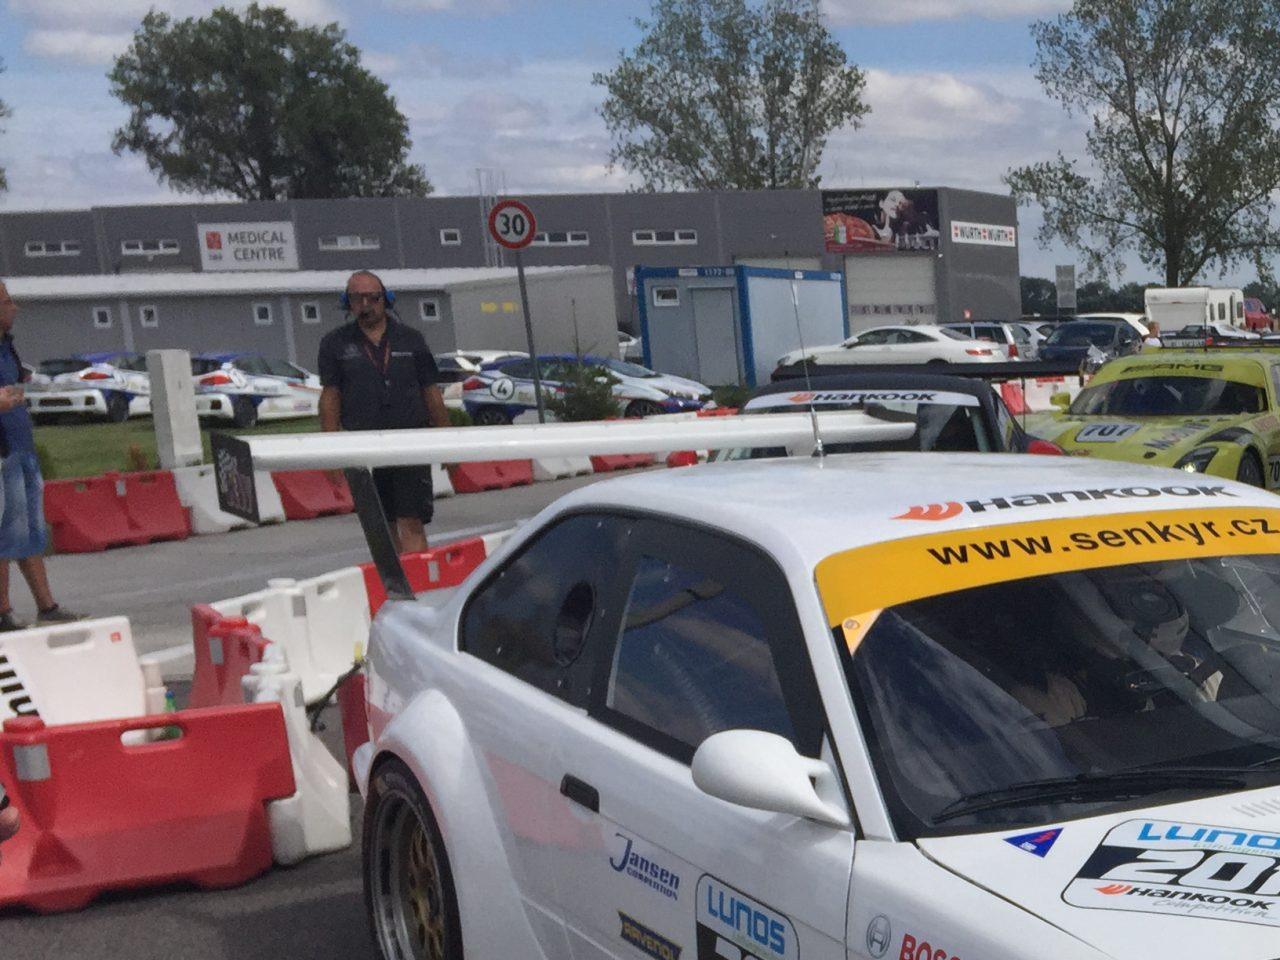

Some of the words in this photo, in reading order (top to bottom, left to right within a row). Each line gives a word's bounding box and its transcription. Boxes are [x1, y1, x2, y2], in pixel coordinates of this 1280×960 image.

[500, 213, 525, 236] 30
[227, 230, 287, 244] MEDICAL
[233, 248, 285, 260] CENTRE
[1160, 363, 1225, 372] AMG
[496, 378, 508, 396] 4
[1084, 423, 1131, 437] 707
[609, 832, 680, 890] Jansen
